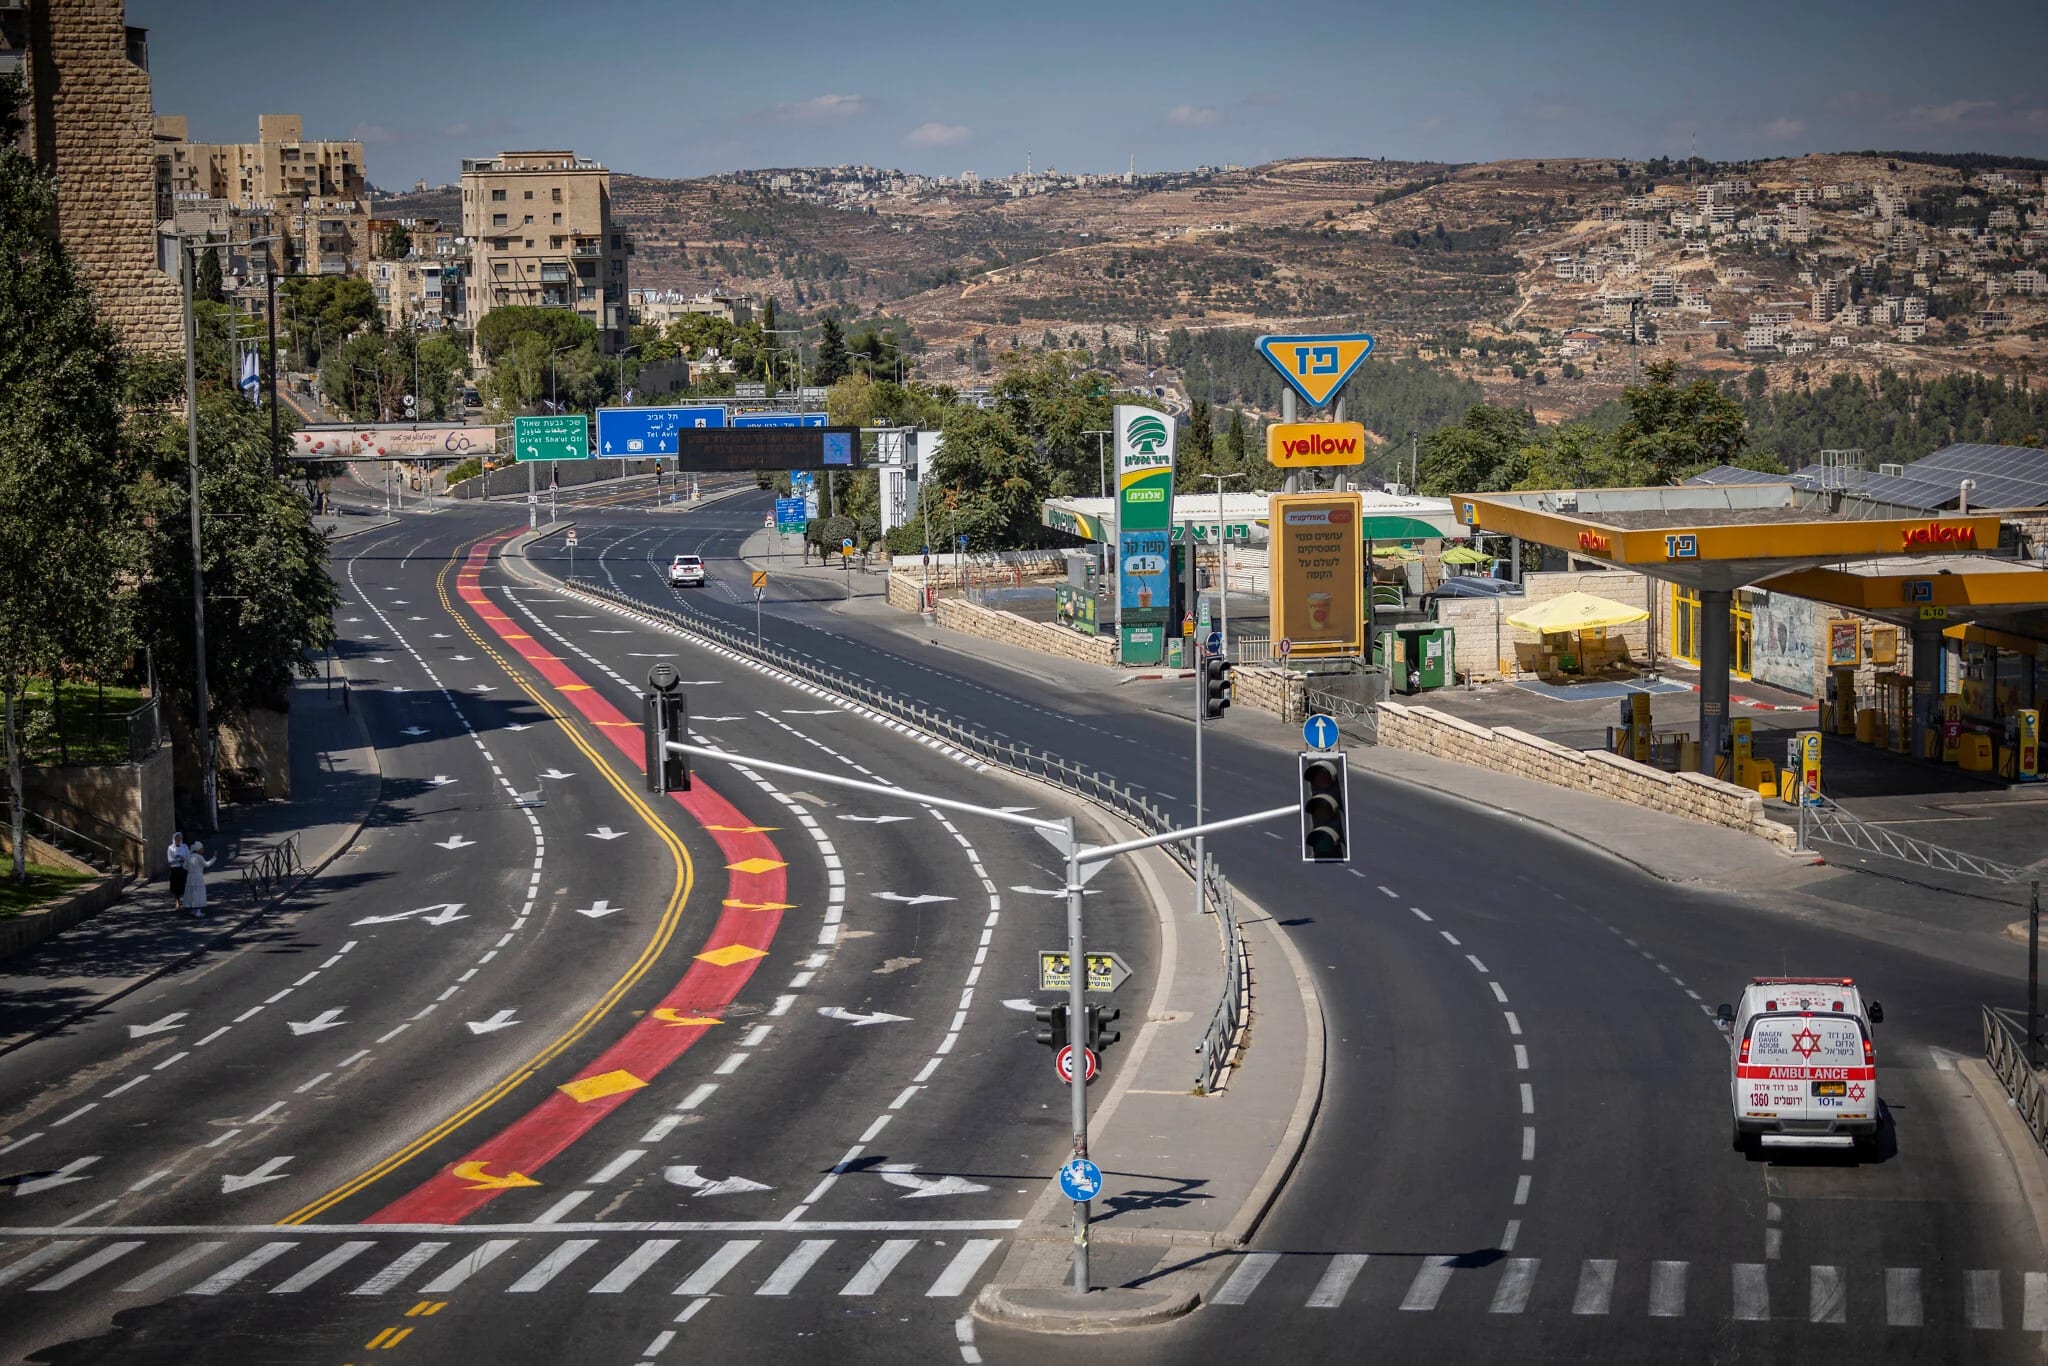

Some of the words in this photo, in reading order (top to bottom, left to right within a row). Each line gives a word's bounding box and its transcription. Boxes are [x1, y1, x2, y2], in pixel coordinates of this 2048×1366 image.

[1295, 346, 1339, 375] פז
[667, 413, 679, 421] תל
[1281, 434, 1356, 460] yellow
[1125, 454, 1152, 467] אלון
[1152, 455, 1170, 464] דור
[1130, 490, 1161, 500] אלונית
[1211, 524, 1249, 540] דור
[1296, 533, 1313, 541] מנוי
[1315, 532, 1343, 541] עושים
[1901, 521, 1974, 548] yellow
[1577, 529, 1608, 551] yellow
[1123, 541, 1139, 555] קר
[1142, 541, 1165, 555] קפה
[1298, 545, 1341, 555] ומפסיקים
[1665, 534, 1697, 558] פז
[1298, 558, 1312, 568] על
[1313, 557, 1340, 567] לשלם
[1306, 571, 1333, 580] הקפה
[1904, 581, 1933, 602] פז
[1923, 608, 1944, 617] 4.10
[1835, 1040, 1855, 1048] אדום
[1824, 1047, 1855, 1056] בישראל
[1769, 1068, 1848, 1079] AMBULANCE
[1754, 1083, 1770, 1091] אדום
[1787, 1084, 1799, 1092] מגן
[1750, 1093, 1769, 1107] 1360
[1774, 1095, 1803, 1105] ירושלים
[1817, 1097, 1835, 1106] 101
